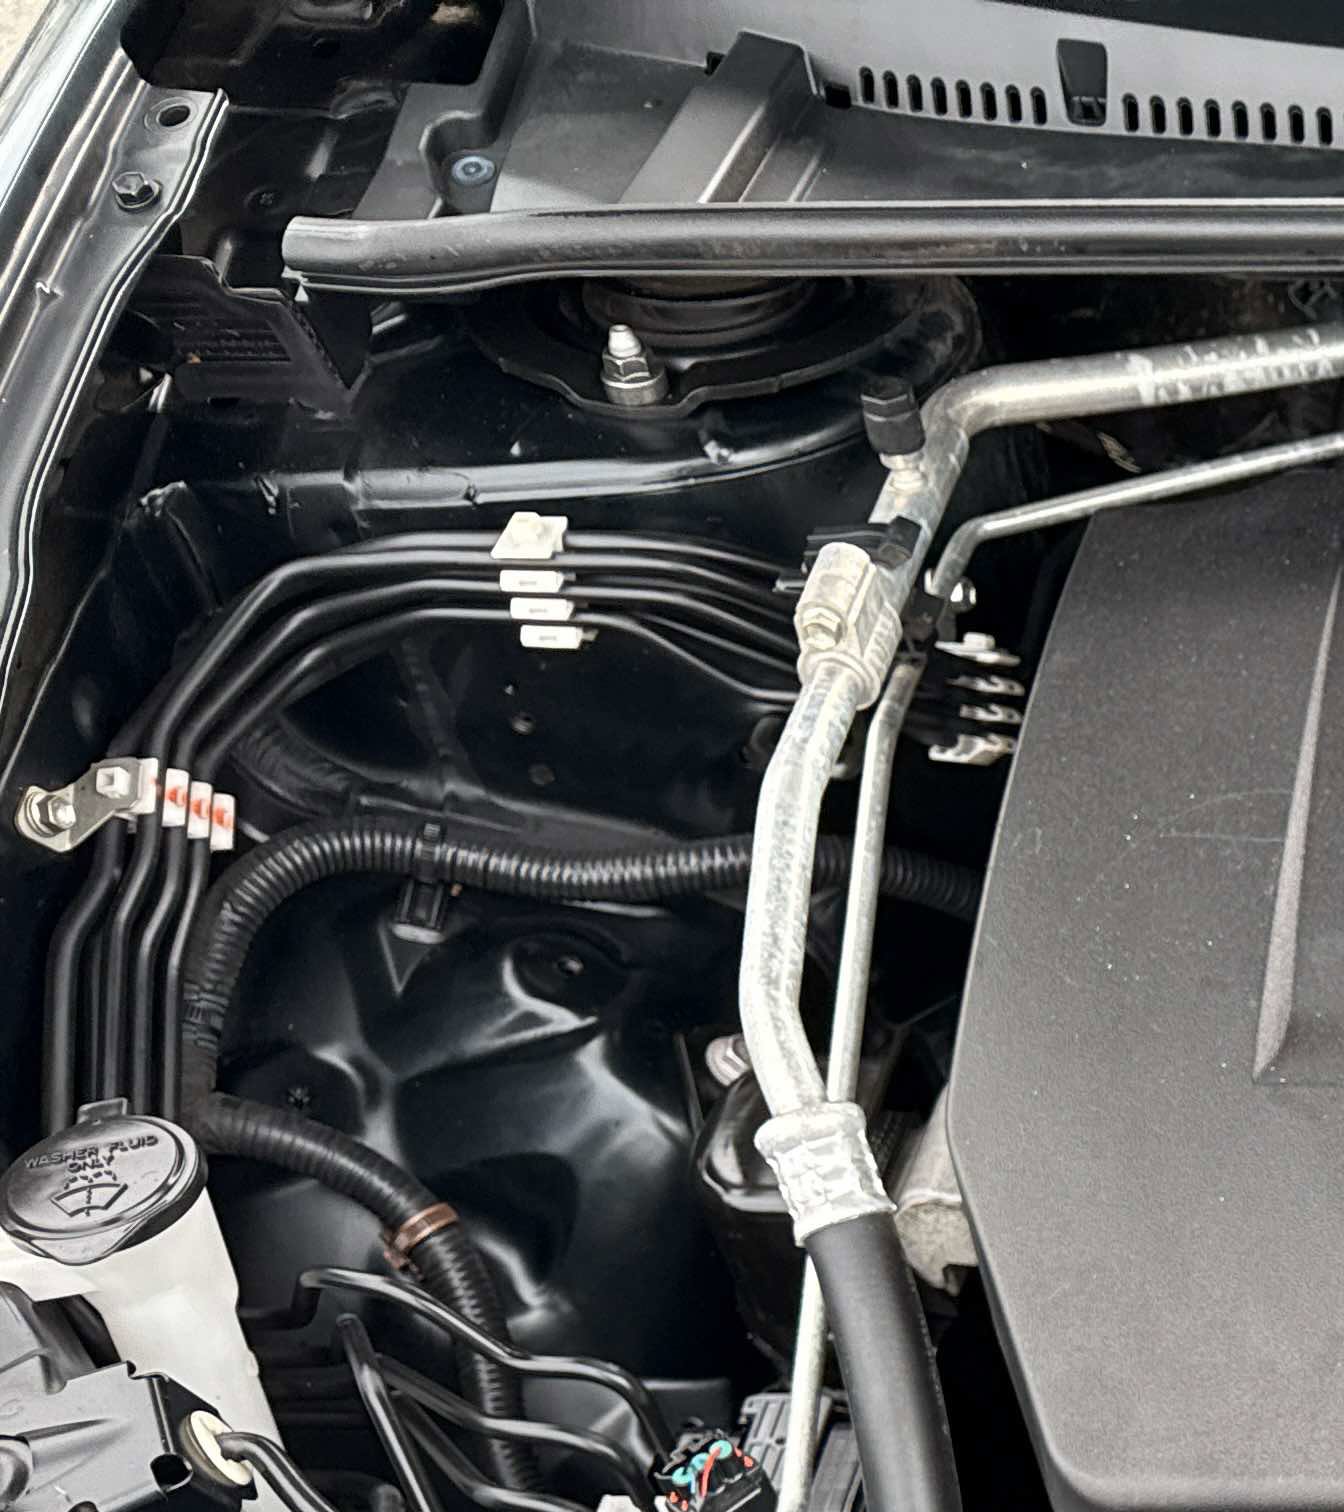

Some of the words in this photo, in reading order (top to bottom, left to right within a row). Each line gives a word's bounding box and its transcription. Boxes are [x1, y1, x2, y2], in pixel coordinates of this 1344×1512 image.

[23, 1146, 100, 1169] WASHER
[107, 1135, 159, 1153] FLUID
[67, 1154, 115, 1173] ONLY
